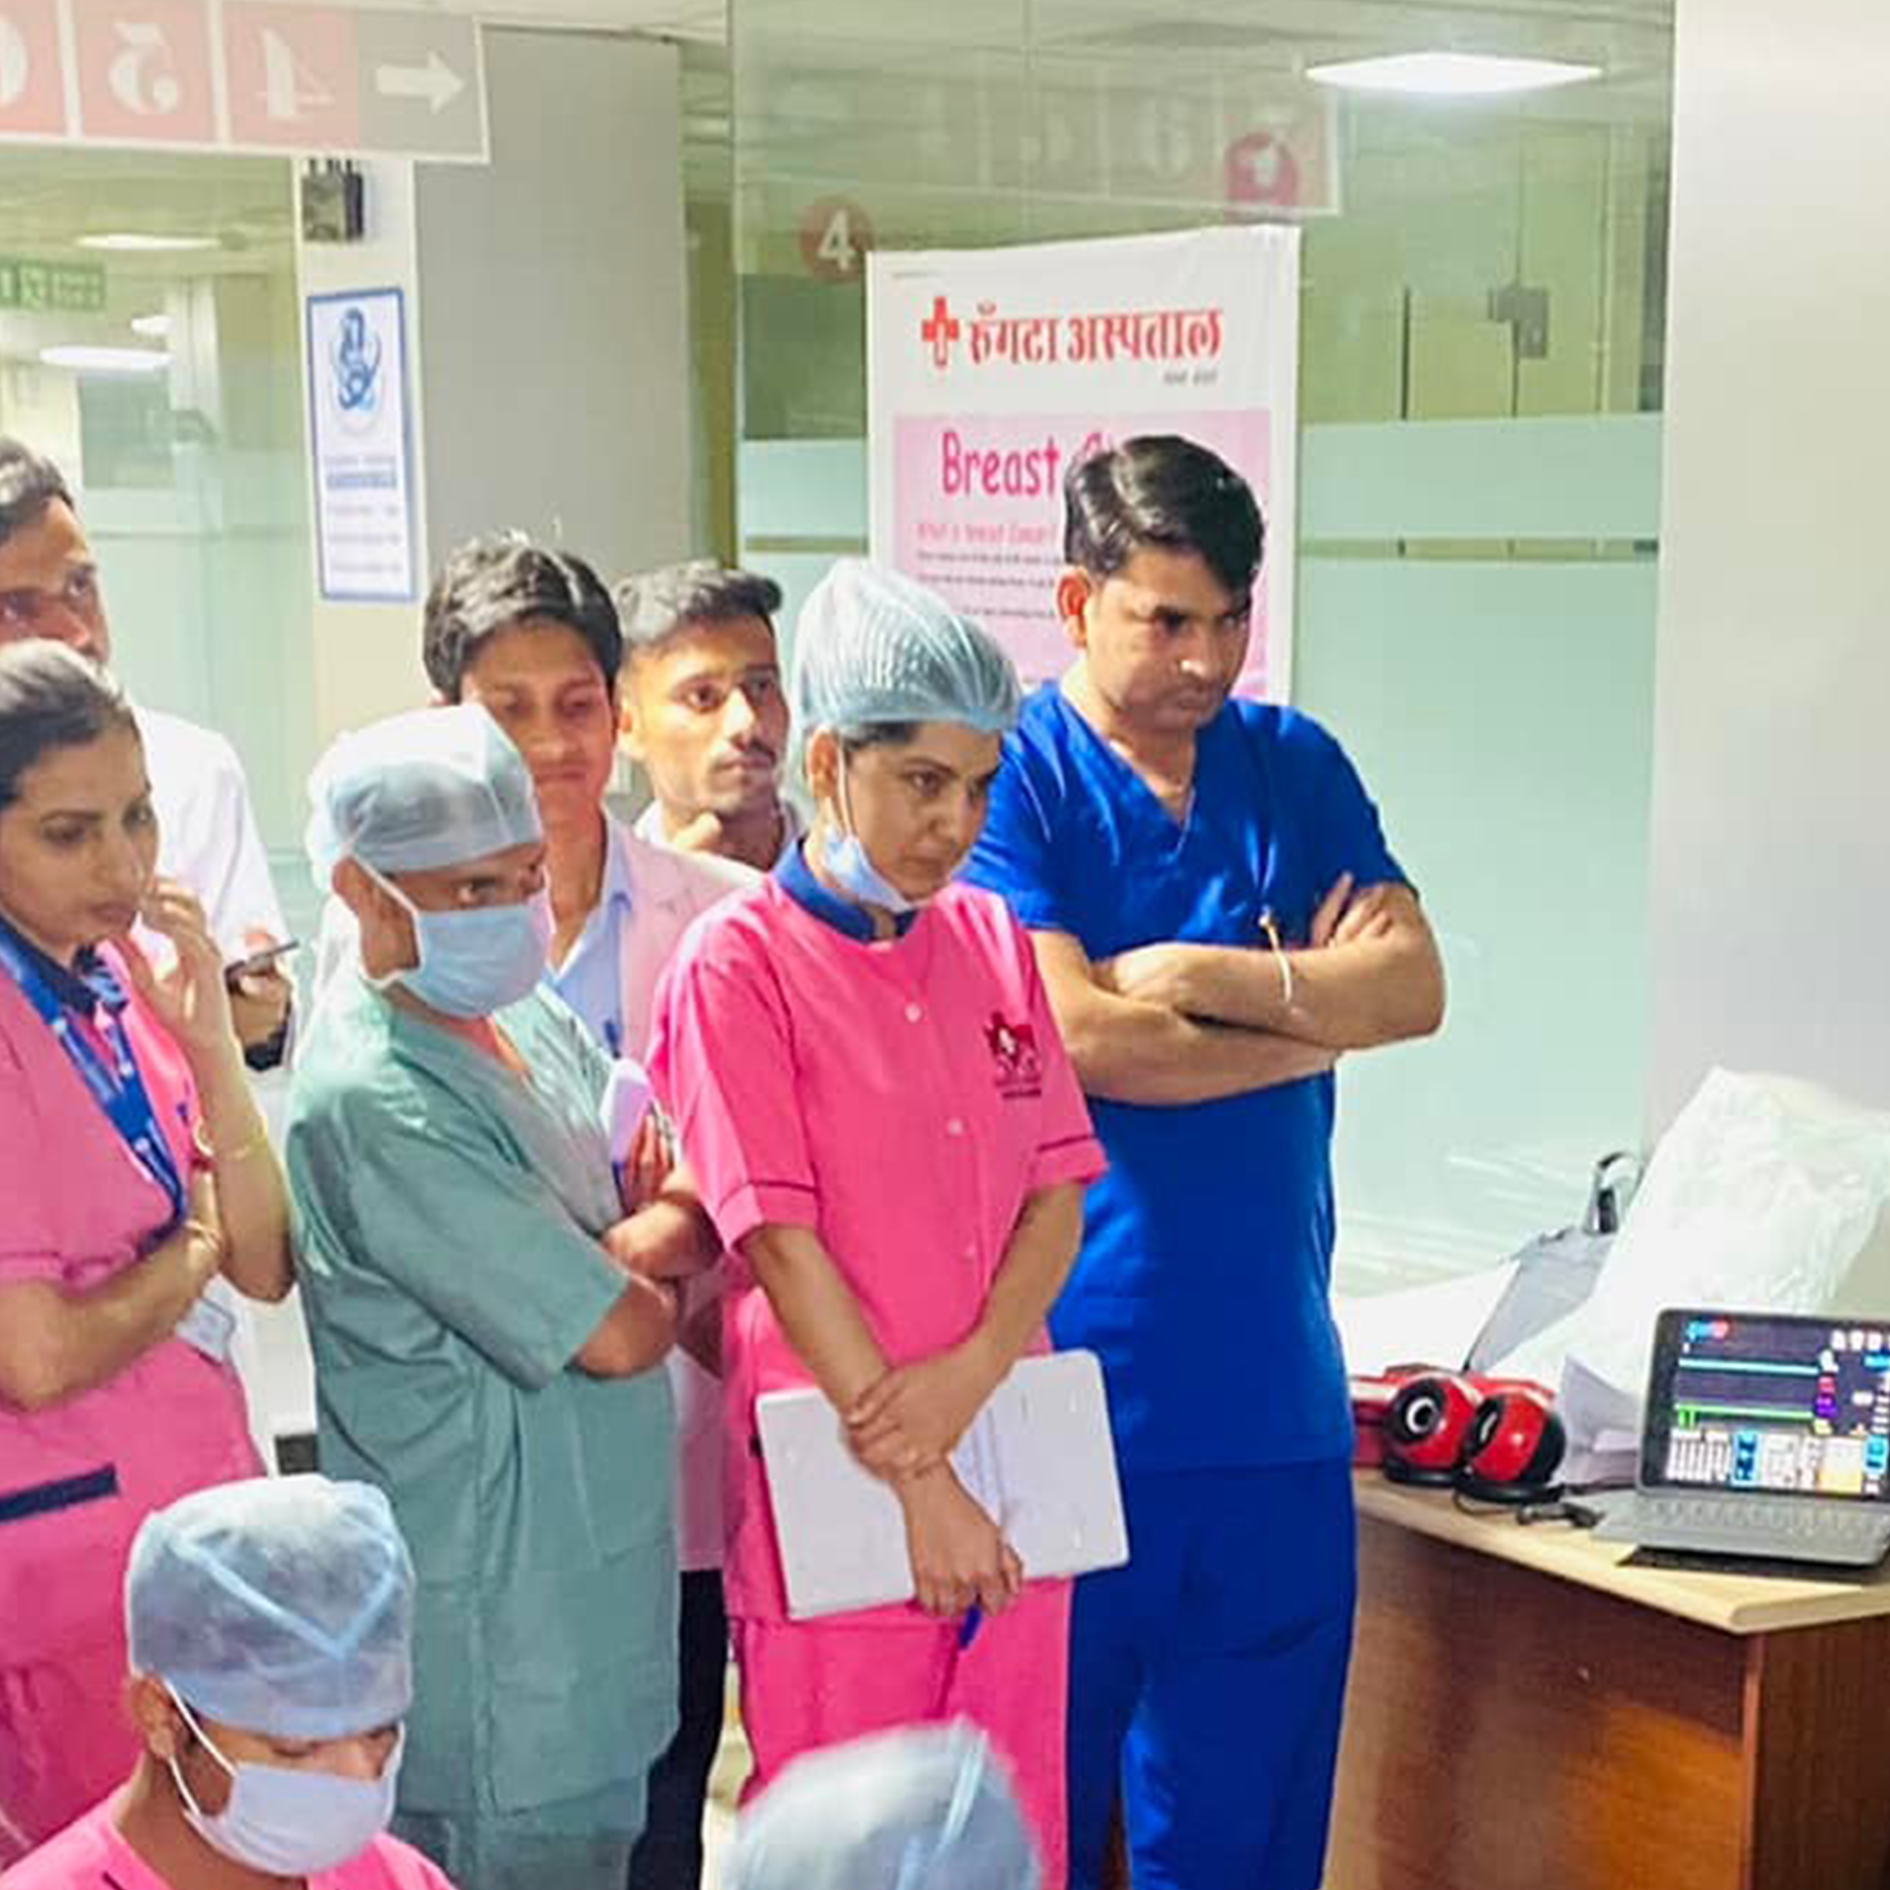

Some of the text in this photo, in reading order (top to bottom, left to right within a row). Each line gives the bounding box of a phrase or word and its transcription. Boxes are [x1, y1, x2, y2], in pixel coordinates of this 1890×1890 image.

[817, 208, 856, 271] 4
[1067, 307, 1223, 365] अस्पताल
[941, 430, 1061, 495] Breast
